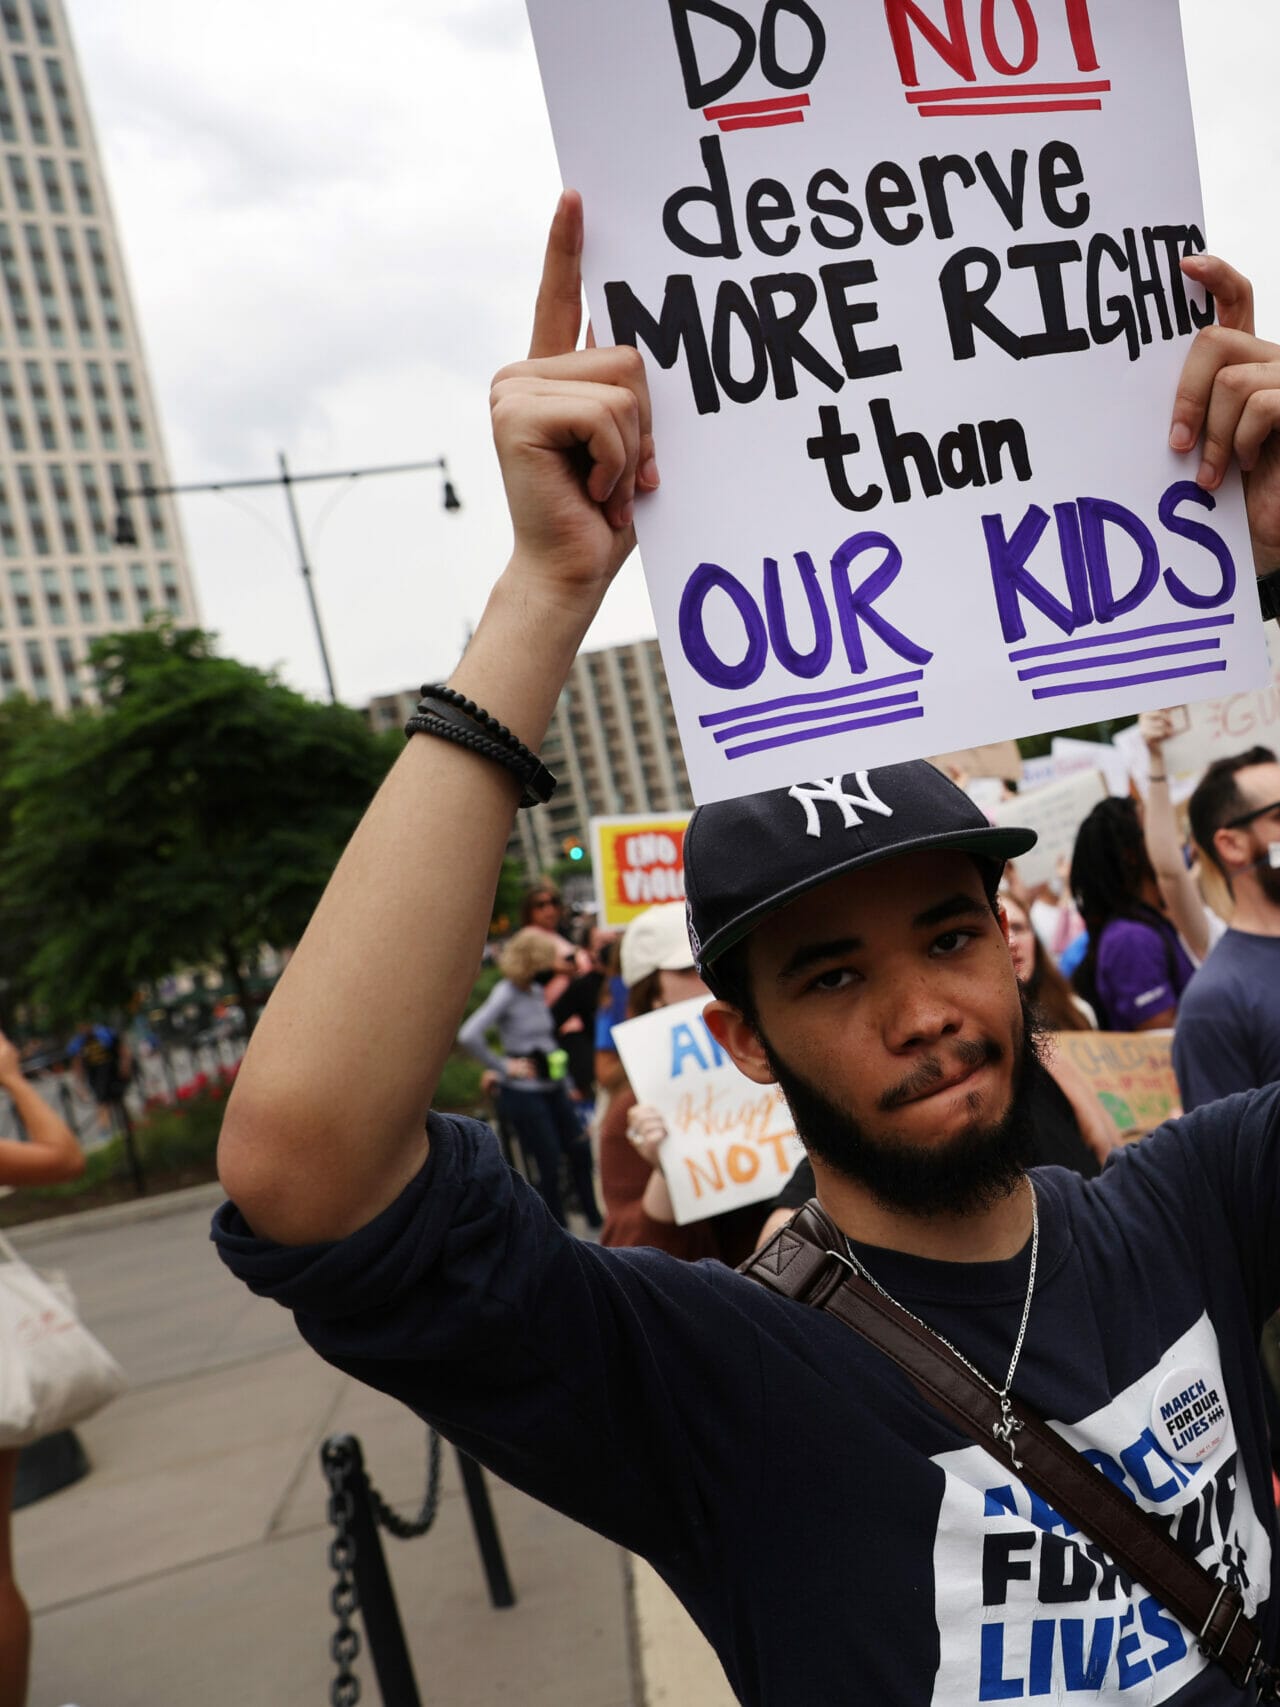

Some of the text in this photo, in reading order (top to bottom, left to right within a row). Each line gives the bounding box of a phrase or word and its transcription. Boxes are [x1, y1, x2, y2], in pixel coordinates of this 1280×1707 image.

[670, 0, 826, 109] DO
[661, 134, 1091, 259] deserve
[603, 225, 1216, 415] MORE RIGHTS
[806, 397, 1033, 512] than
[679, 480, 1238, 691] OUR KIDS
[626, 831, 677, 868] END
[683, 1130, 798, 1199] NOT
[1160, 1379, 1207, 1421] MARCH
[1165, 1389, 1220, 1437] FOR OUR
[1172, 1416, 1210, 1452] LIVES
[982, 1530, 1134, 1607] FOR
[979, 1596, 1187, 1702] LIVES
